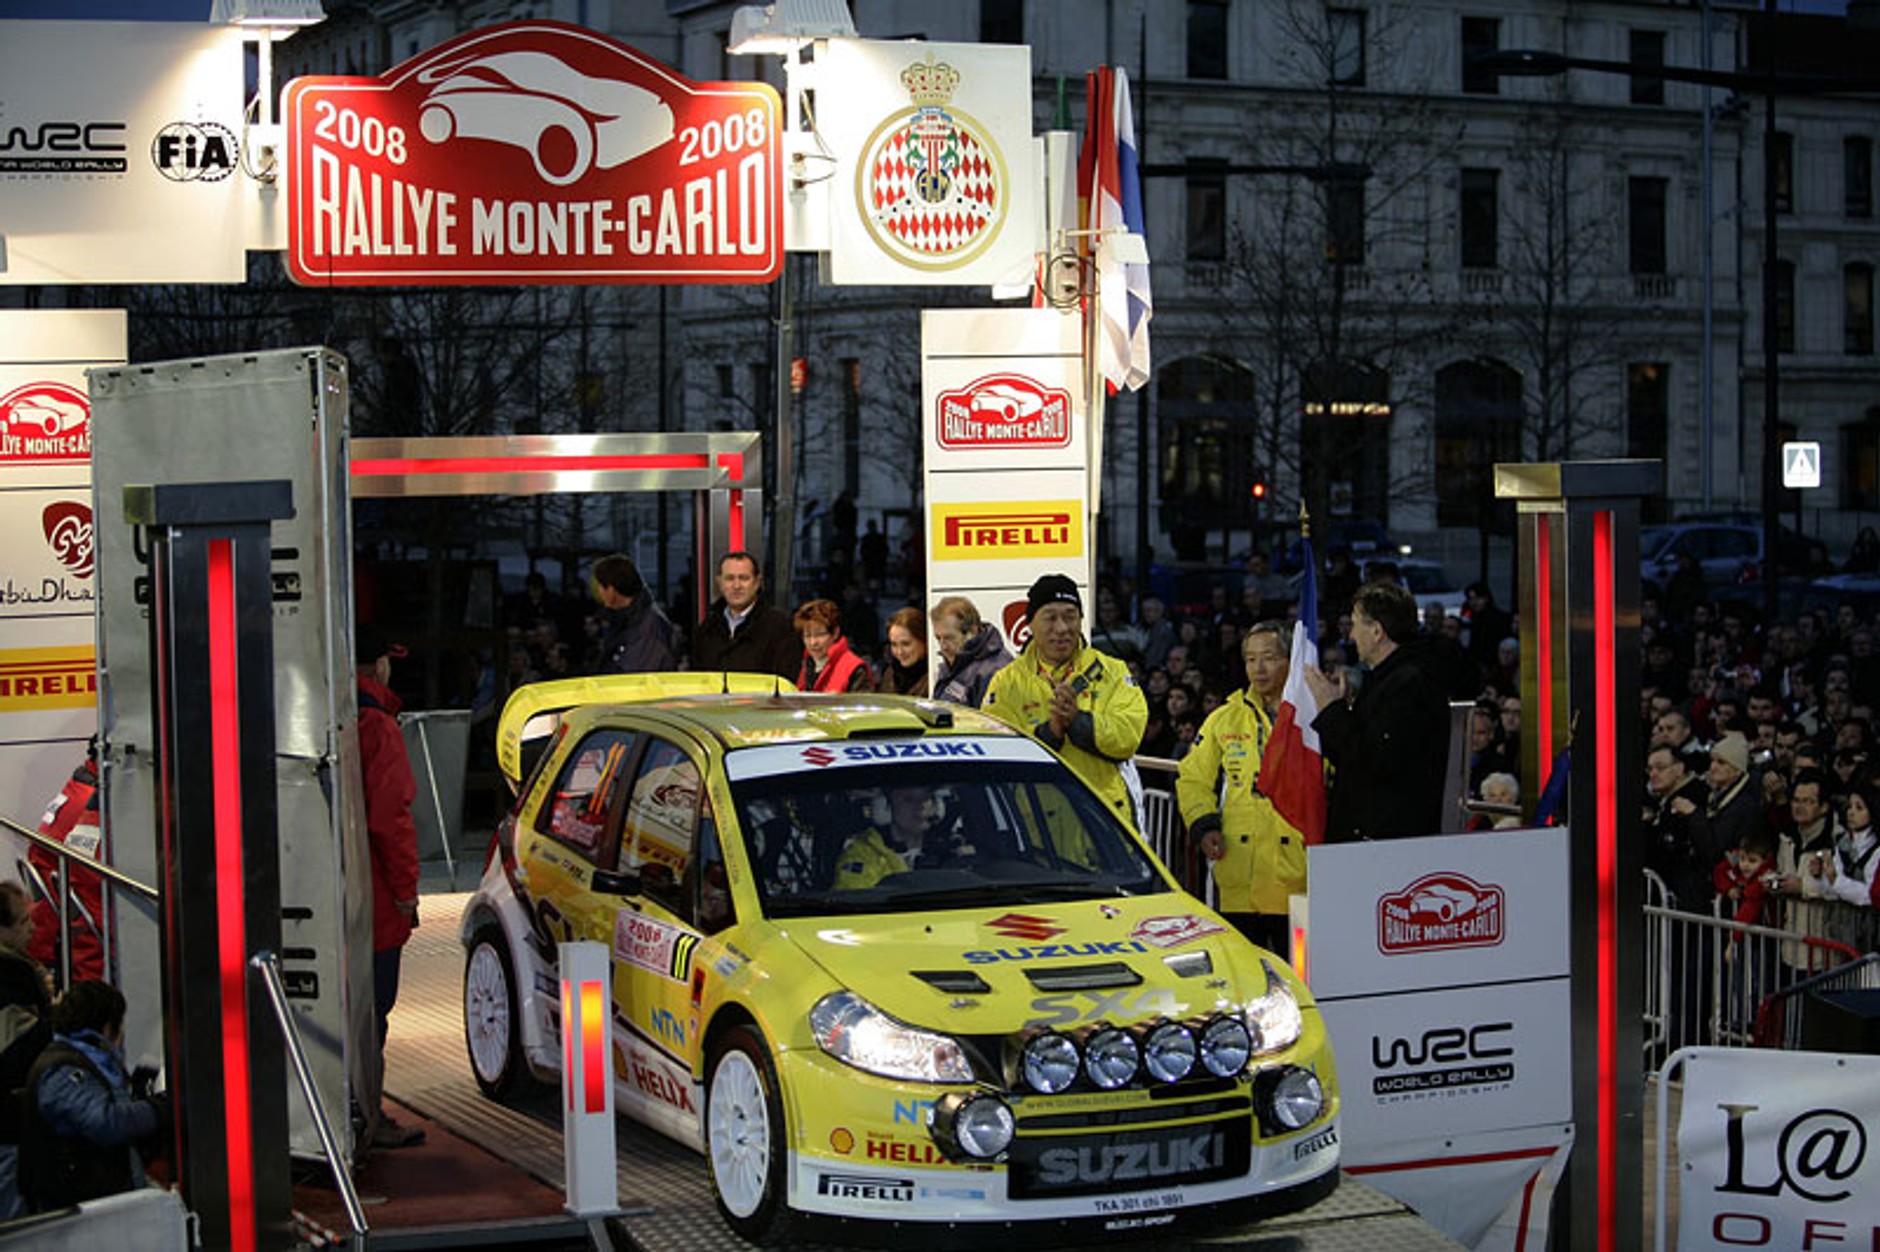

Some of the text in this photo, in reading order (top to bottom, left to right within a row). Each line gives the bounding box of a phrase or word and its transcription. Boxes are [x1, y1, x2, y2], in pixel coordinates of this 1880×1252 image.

[314, 99, 407, 165] 2008
[678, 108, 766, 166] 2008
[312, 143, 767, 256] RALLYE MONTE-CARLO
[945, 411, 1064, 440] RALLYE MONTE-CARLO
[945, 514, 1070, 546] PIRELLI
[843, 743, 986, 760] SUZUKI
[629, 918, 663, 943] 2008
[1385, 908, 1498, 945] RALLYE MONTE-CARLO
[963, 941, 1148, 964] SUZUKI
[1022, 987, 1190, 1029] SX4
[651, 1005, 685, 1048] NTN
[1372, 1022, 1514, 1069] WRC
[1377, 1067, 1510, 1092] WORLD RALLY
[1038, 1132, 1225, 1184] SUZUKI
[817, 1173, 915, 1202] PIRELLI
[1094, 1199, 1119, 1212] TKA
[1121, 1198, 1140, 1210] 301
